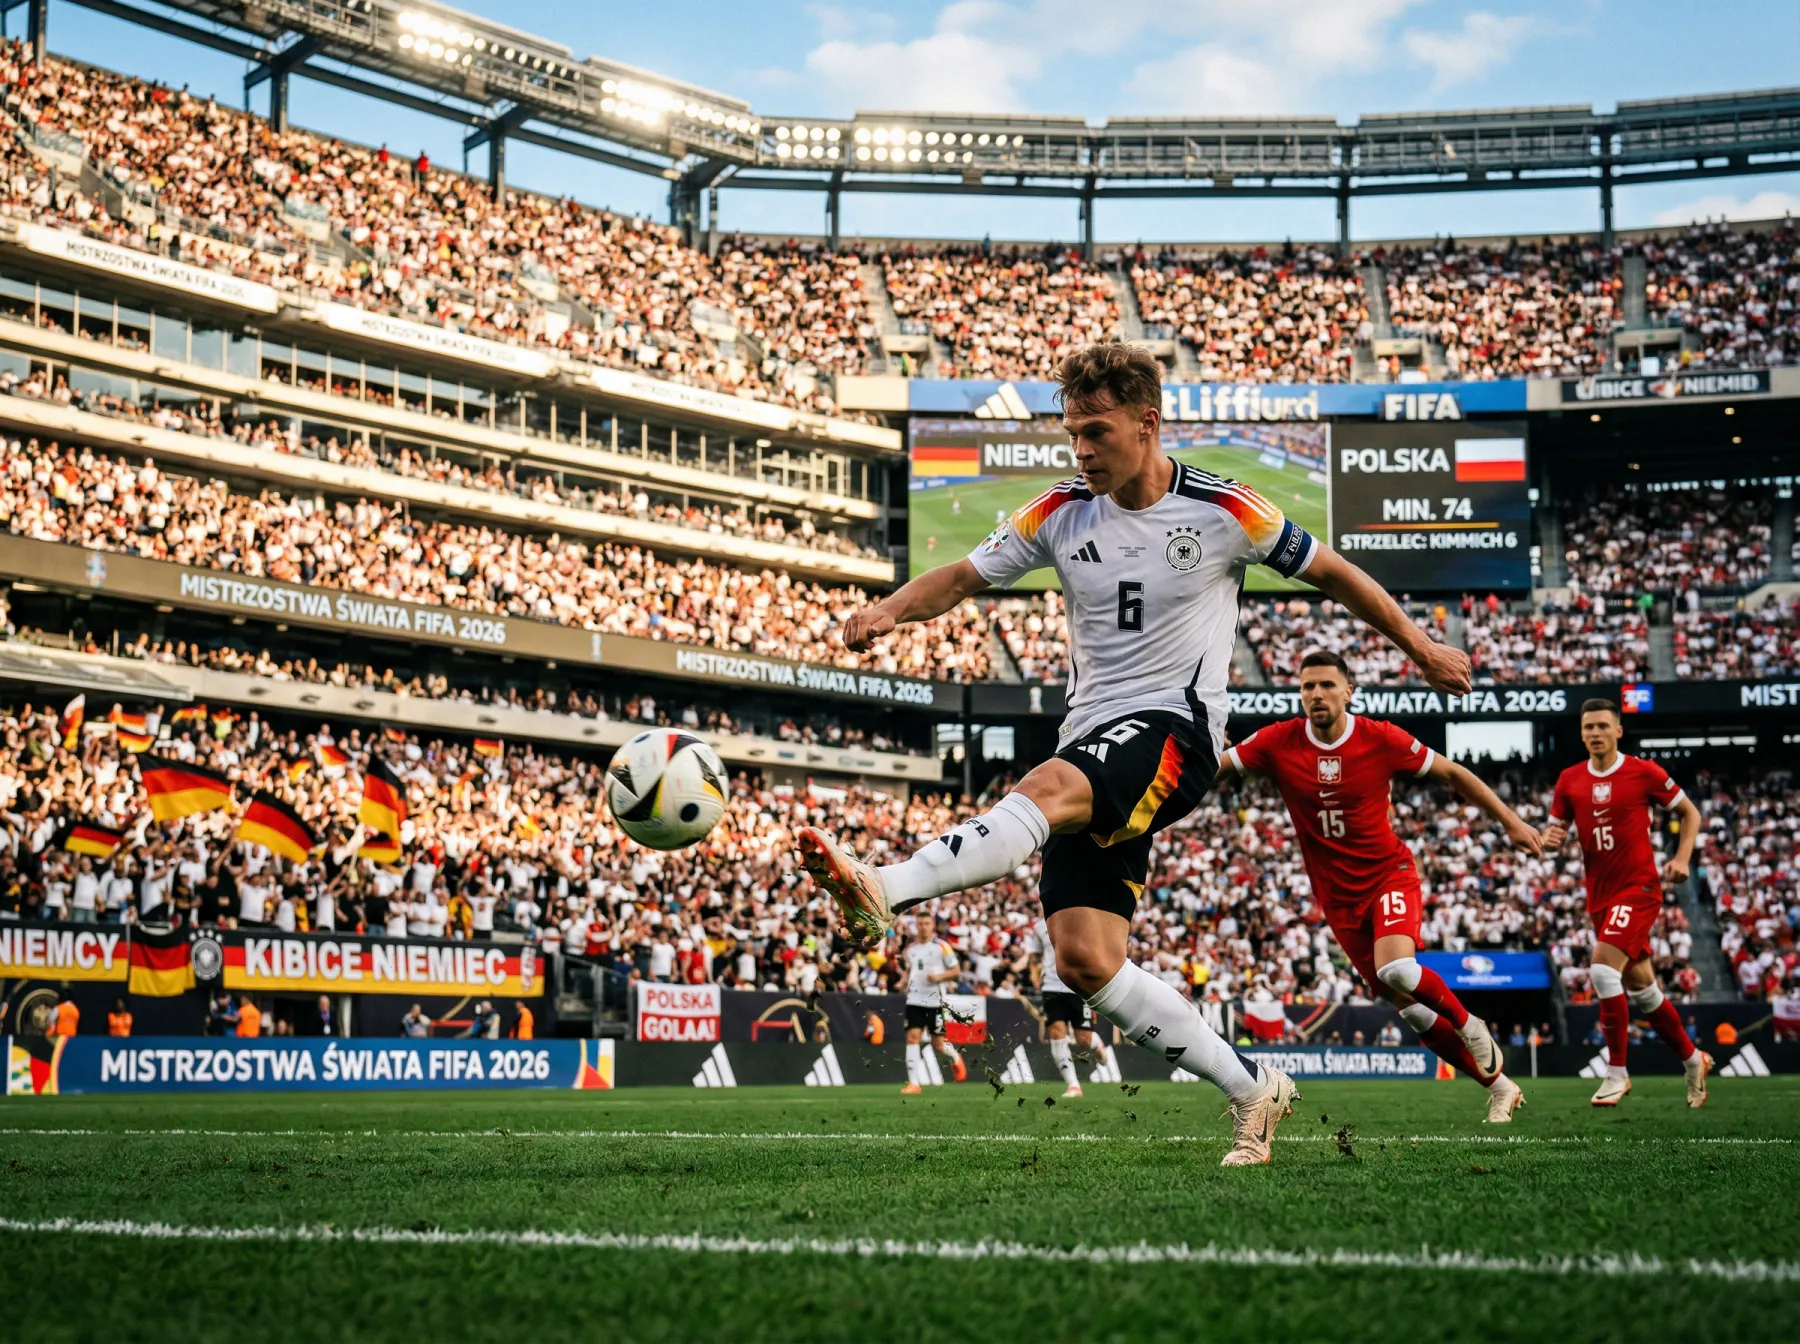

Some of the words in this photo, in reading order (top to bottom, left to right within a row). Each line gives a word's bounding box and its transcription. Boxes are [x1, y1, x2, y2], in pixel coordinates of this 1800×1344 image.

[1384, 393, 1461, 421] FIFA
[1340, 448, 1450, 473] POLSKA
[1382, 498, 1437, 521] MIN.
[1442, 497, 1474, 520] 74
[1430, 532, 1503, 549] KIMMICH
[1505, 531, 1518, 548] 6
[180, 573, 331, 619] MISTRZOSTWA
[336, 593, 411, 630] ŚWIATA
[414, 610, 456, 637] FIFA
[459, 617, 506, 644] 2026
[1118, 580, 1145, 633] 6
[676, 651, 796, 686] MISTRZOSTWA
[796, 663, 857, 694] ŚWIATA
[859, 676, 894, 699] FIFA
[894, 681, 934, 704] 2026
[1350, 687, 1443, 714] ŚWIATA
[1448, 691, 1501, 713] FIFA
[1504, 690, 1567, 712] 2026
[1741, 683, 1800, 707] MIST
[1100, 719, 1150, 745] 6
[1317, 810, 1346, 838] 15
[1592, 826, 1614, 851] 15
[1379, 891, 1407, 916] 15
[1609, 905, 1632, 928] 15
[244, 938, 363, 980] KIBICE
[371, 943, 507, 985] NIEMIEC
[646, 988, 713, 1009] POLSKA
[101, 1049, 316, 1082] MISTRZOSTWA
[322, 1041, 424, 1081] ŚWIATA
[428, 1050, 485, 1080] FIFA
[489, 1050, 550, 1080] 2026
[1370, 1053, 1395, 1074] FIFA
